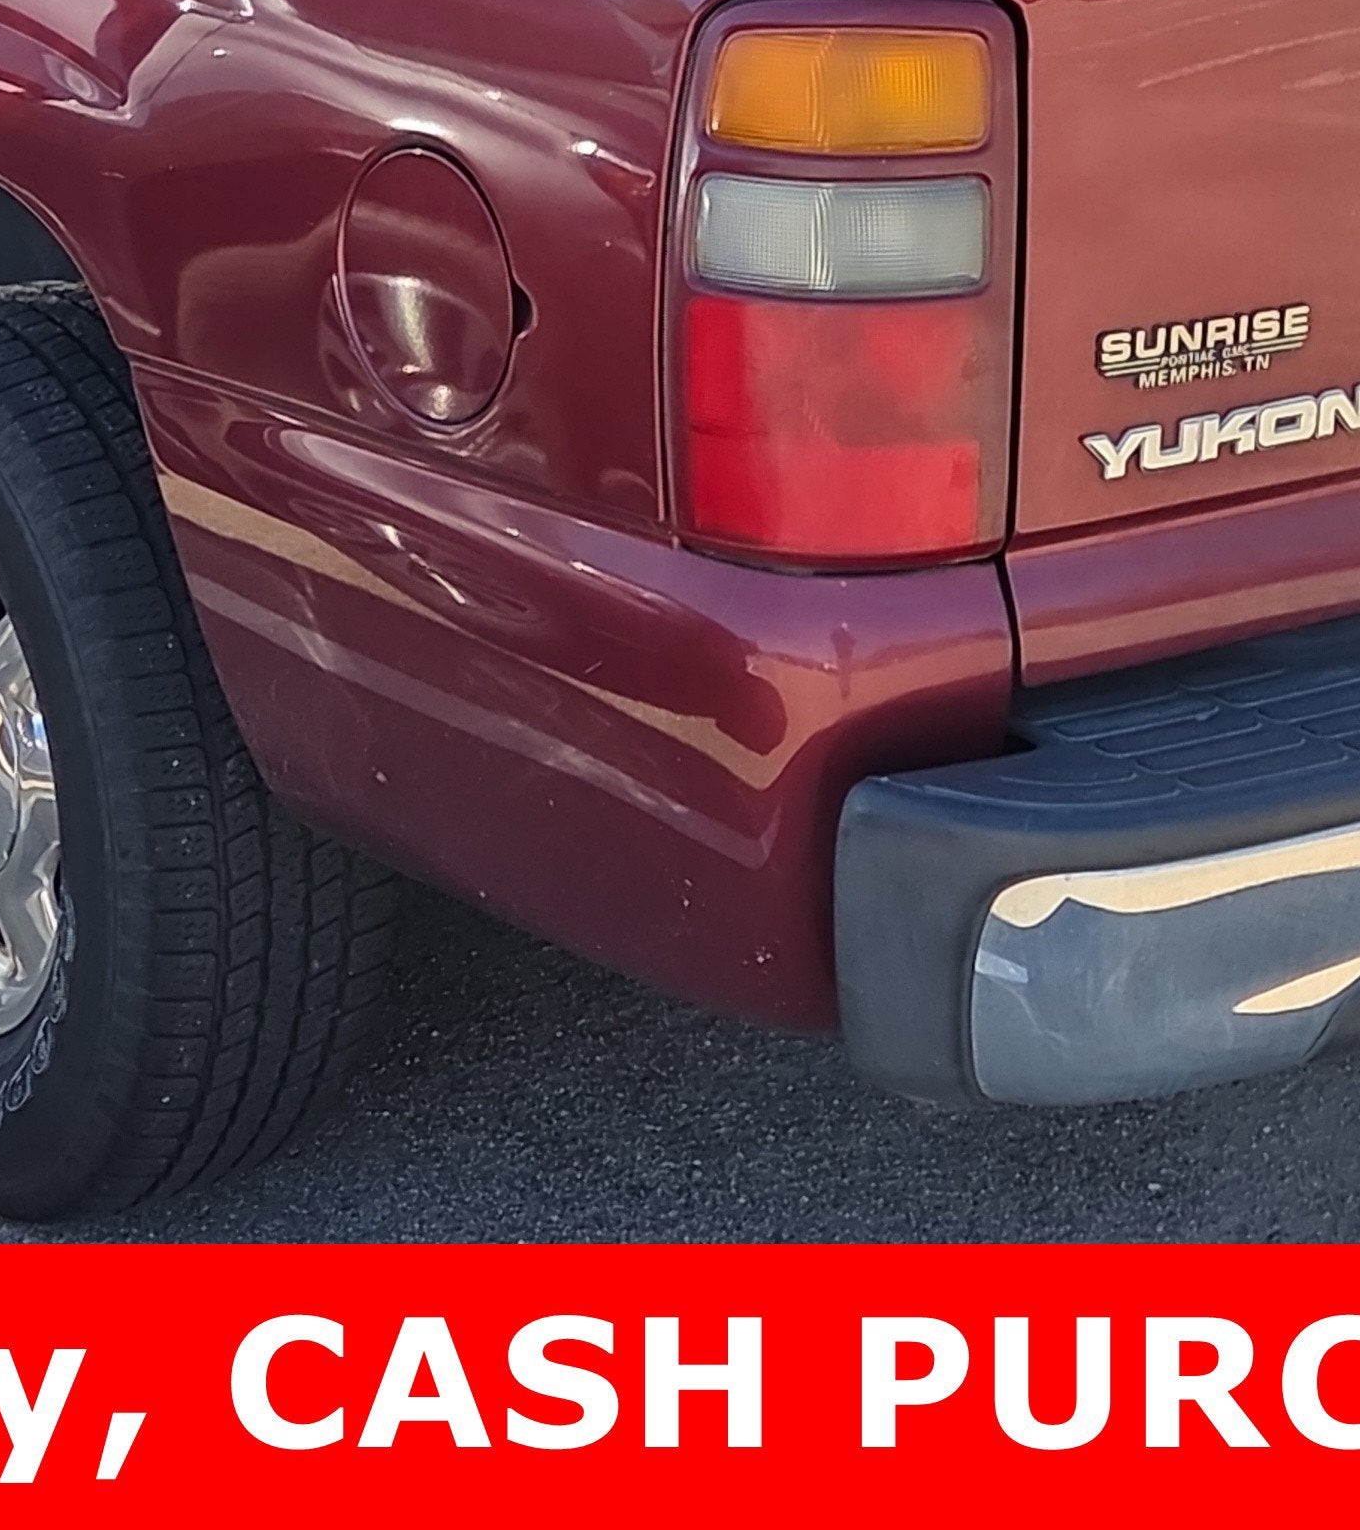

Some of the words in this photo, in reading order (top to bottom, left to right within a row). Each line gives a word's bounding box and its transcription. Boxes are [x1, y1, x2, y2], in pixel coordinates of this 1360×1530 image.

[1100, 304, 1311, 364] SUNRISE
[1159, 348, 1216, 368] PONTIAC
[1244, 353, 1271, 372] TN
